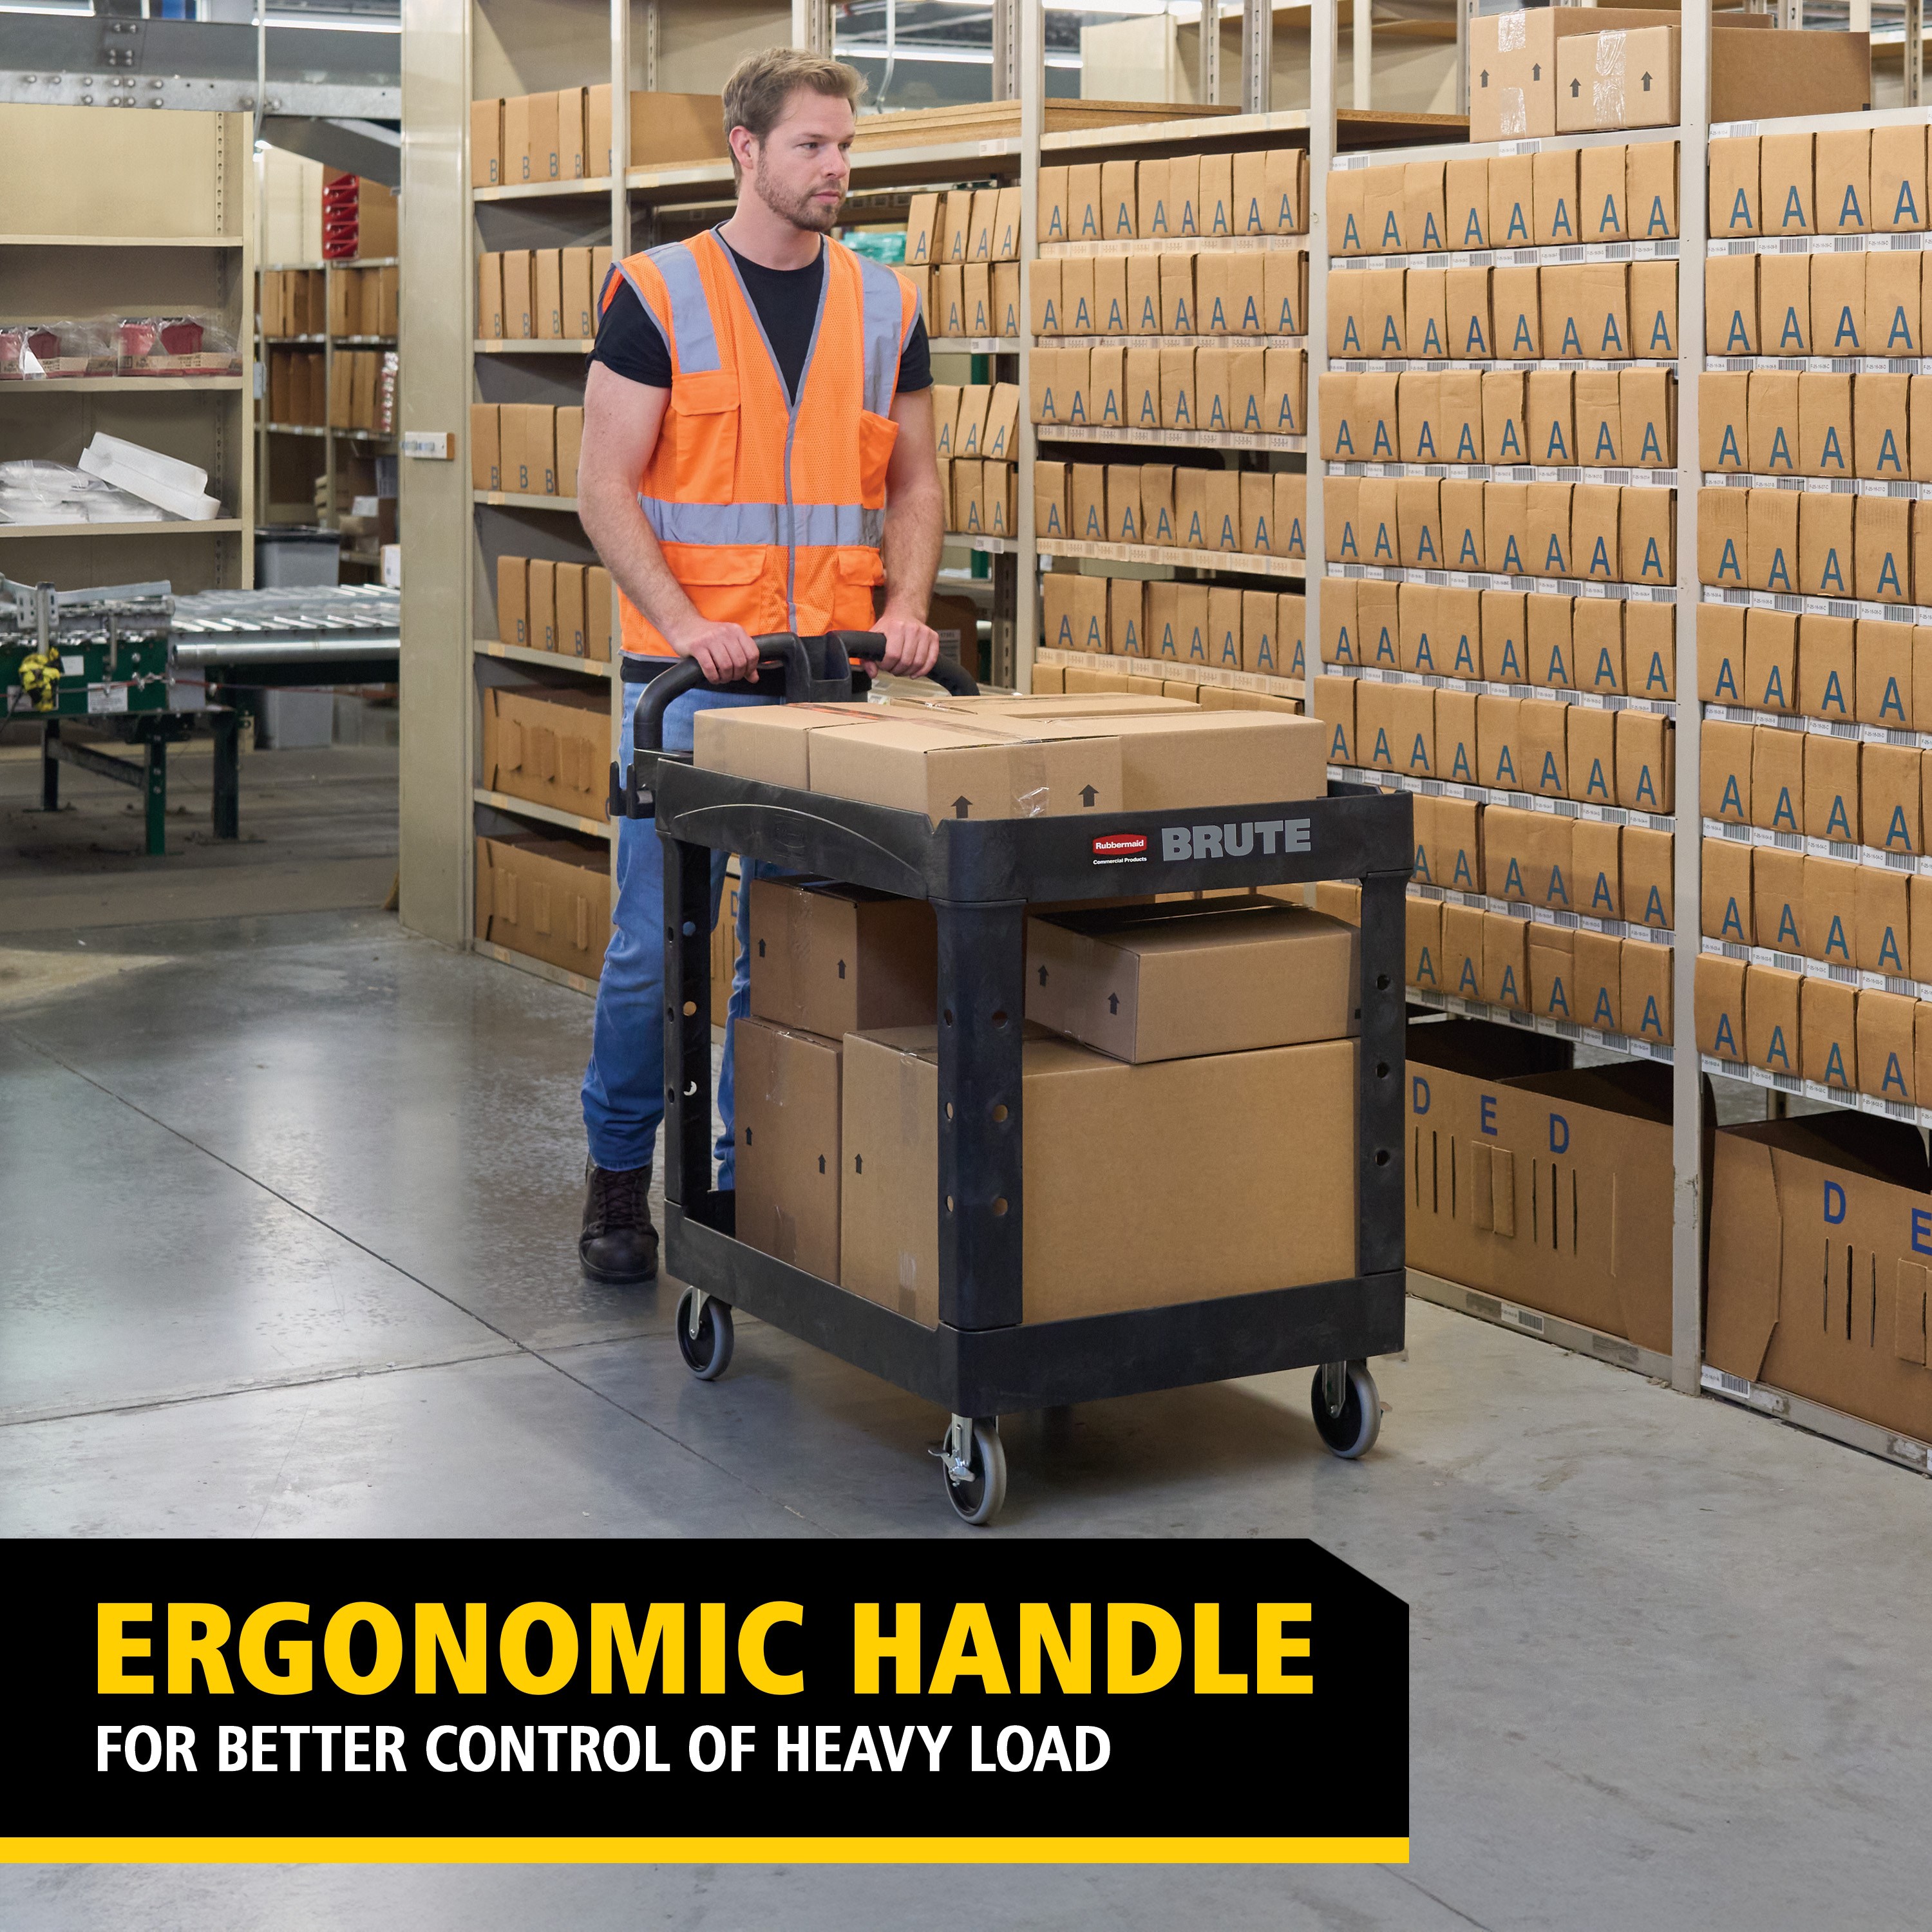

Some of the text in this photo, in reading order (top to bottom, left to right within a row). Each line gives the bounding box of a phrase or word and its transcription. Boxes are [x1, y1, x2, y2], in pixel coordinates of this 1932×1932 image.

[490, 159, 498, 182] B
[523, 156, 530, 180] B
[550, 153, 558, 176] B
[575, 155, 582, 178] B
[1050, 206, 1062, 235] A
[1083, 204, 1096, 234] A
[1117, 203, 1132, 234] A
[1152, 201, 1167, 232] A
[1182, 200, 1195, 232] A
[1213, 200, 1227, 232] A
[1247, 198, 1262, 231] A
[1279, 194, 1293, 227] A
[1552, 198, 1571, 236] A
[1600, 194, 1620, 232] A
[1648, 196, 1667, 236] A
[1730, 188, 1752, 228] A
[1783, 185, 1806, 227] A
[1839, 185, 1864, 226] A
[1893, 180, 1918, 224] A
[1343, 213, 1360, 249] A
[1382, 211, 1401, 247] A
[1423, 212, 1441, 247] A
[1464, 208, 1482, 245] A
[1508, 203, 1528, 240] A
[914, 231, 927, 260] A
[977, 229, 987, 256] A
[523, 313, 531, 336] B
[553, 310, 560, 334] B
[582, 312, 589, 336] B
[949, 303, 960, 330] A
[976, 301, 987, 330] A
[1142, 296, 1156, 328] A
[1211, 297, 1226, 330] A
[1242, 296, 1259, 330] A
[1728, 310, 1750, 350] A
[1781, 307, 1803, 348] A
[1835, 306, 1859, 347] A
[1888, 306, 1913, 349] A
[938, 423, 951, 454] A
[965, 423, 978, 454] A
[992, 426, 1005, 453] A
[1336, 420, 1354, 454] A
[1374, 420, 1392, 456] A
[1417, 421, 1436, 457] A
[1457, 422, 1476, 460] A
[1501, 419, 1520, 455] A
[1548, 421, 1567, 459] A
[1595, 422, 1616, 460] A
[1641, 422, 1660, 460] A
[1719, 424, 1741, 466] A
[1769, 427, 1793, 469] A
[1821, 426, 1844, 468] A
[1877, 429, 1901, 471] A
[520, 465, 528, 488] B
[546, 469, 554, 493] B
[1048, 504, 1061, 533] A
[1087, 505, 1100, 536] A
[1122, 507, 1135, 537] A
[1157, 507, 1171, 538] A
[1189, 511, 1202, 542] A
[1220, 515, 1235, 547] A
[1255, 516, 1269, 549] A
[1289, 518, 1304, 552] A
[1719, 538, 1741, 580] A
[1769, 548, 1790, 590] A
[1821, 548, 1844, 591] A
[1877, 553, 1901, 596] A
[575, 631, 583, 655] B
[1336, 627, 1353, 663] A
[1377, 627, 1395, 663] A
[1416, 633, 1434, 670] A
[1455, 635, 1473, 672] A
[1501, 639, 1520, 677] A
[1548, 645, 1567, 684] A
[1595, 647, 1616, 687] A
[1647, 652, 1667, 692] A
[1716, 658, 1738, 699] A
[1764, 665, 1785, 708] A
[1822, 670, 1846, 713] A
[1880, 677, 1906, 721] A
[1410, 734, 1429, 770] A
[1453, 743, 1471, 781] A
[1497, 745, 1516, 783] A
[1540, 752, 1561, 790] A
[1587, 759, 1607, 797] A
[1636, 765, 1655, 804] A
[1721, 775, 1743, 817] A
[1774, 787, 1796, 829] A
[1827, 795, 1850, 838] A
[1095, 840, 1144, 849] Rubbermaid
[1161, 818, 1311, 861] BRUTE
[1886, 806, 1911, 849] A
[1722, 897, 1743, 939] A
[1778, 904, 1801, 947] A
[1825, 915, 1849, 959] A
[1419, 947, 1435, 983] A
[1879, 927, 1902, 971] A
[1460, 958, 1477, 993] A
[1501, 965, 1518, 1004] A
[1550, 977, 1568, 1015] A
[1595, 987, 1613, 1026] A
[1642, 995, 1662, 1035] A
[1716, 1013, 1736, 1054] A
[1767, 1026, 1789, 1068] A
[1825, 1043, 1846, 1084] A
[1882, 1052, 1907, 1095] A
[1414, 1078, 1569, 1154] D E D
[1824, 1180, 1932, 1257] D E
